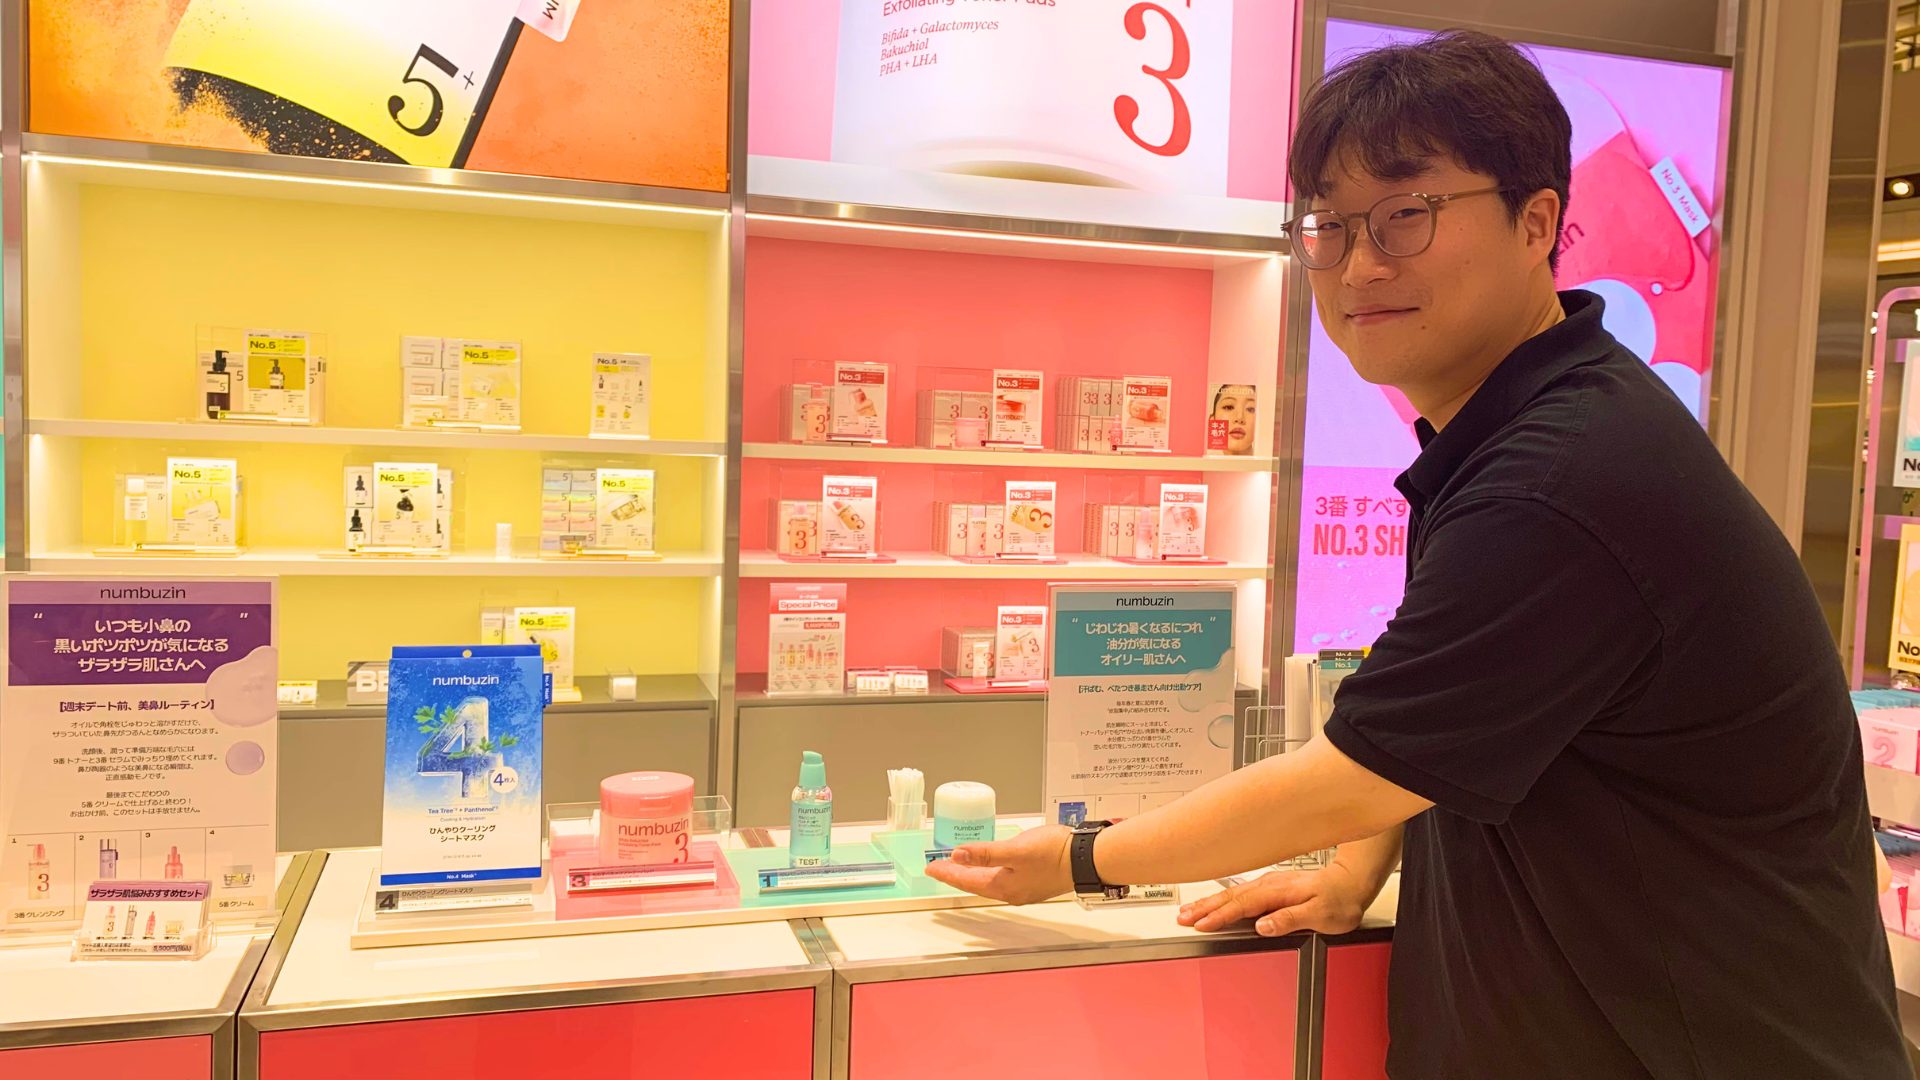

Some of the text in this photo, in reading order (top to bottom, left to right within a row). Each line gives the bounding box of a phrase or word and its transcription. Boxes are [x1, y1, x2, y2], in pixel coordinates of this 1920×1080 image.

[882, 28, 909, 45] Bifida
[920, 20, 999, 34] Galactomyces
[880, 38, 929, 62] Bakuchiol
[880, 60, 900, 76] PHA
[912, 53, 938, 68] LHA
[1114, 2, 1192, 156] 3
[250, 341, 276, 350] No.5
[465, 351, 488, 360] No.5
[236, 370, 244, 381] 5
[840, 373, 862, 382] No.3
[1128, 386, 1147, 394] No.3
[950, 404, 959, 418] 3
[816, 414, 826, 434] 3
[174, 470, 200, 478] No.5
[1315, 496, 1348, 518] 3番
[850, 514, 865, 530] 3
[1110, 522, 1118, 536] 3
[958, 523, 967, 540] 3
[994, 524, 1004, 540] 3
[1126, 522, 1134, 537] 3
[795, 530, 806, 550] 3
[1313, 524, 1404, 556] NO.3 SH
[100, 586, 186, 599] numbuzin
[780, 602, 812, 610] Special
[1116, 596, 1174, 607] numbuzin
[95, 619, 190, 633] いつも小鼻の
[1086, 622, 1203, 635] じわじわ暑くなるにつれ
[54, 638, 229, 653] 黒いポツポツが気になる
[1029, 638, 1040, 652] 3
[1106, 638, 1180, 650] 油分が気になる
[78, 658, 206, 673] ザラザラ肌さんへ
[1101, 654, 1186, 666] オイリー肌さんへ
[432, 675, 500, 686] numbuzin
[417, 696, 504, 798] 4
[1872, 736, 1896, 768] 2
[430, 825, 496, 834] ひんやりクーリング
[618, 818, 688, 836] numbuzin
[440, 834, 484, 842] シートマスク
[674, 832, 688, 864] 3
[37, 873, 50, 892] 3
[572, 875, 586, 887] 3
[762, 874, 771, 887] 1
[90, 888, 202, 899] ザラザラ肌悩みおすすめセット
[378, 894, 396, 910] 4
[26, 910, 65, 918] クレンジング
[108, 922, 114, 932] 3
